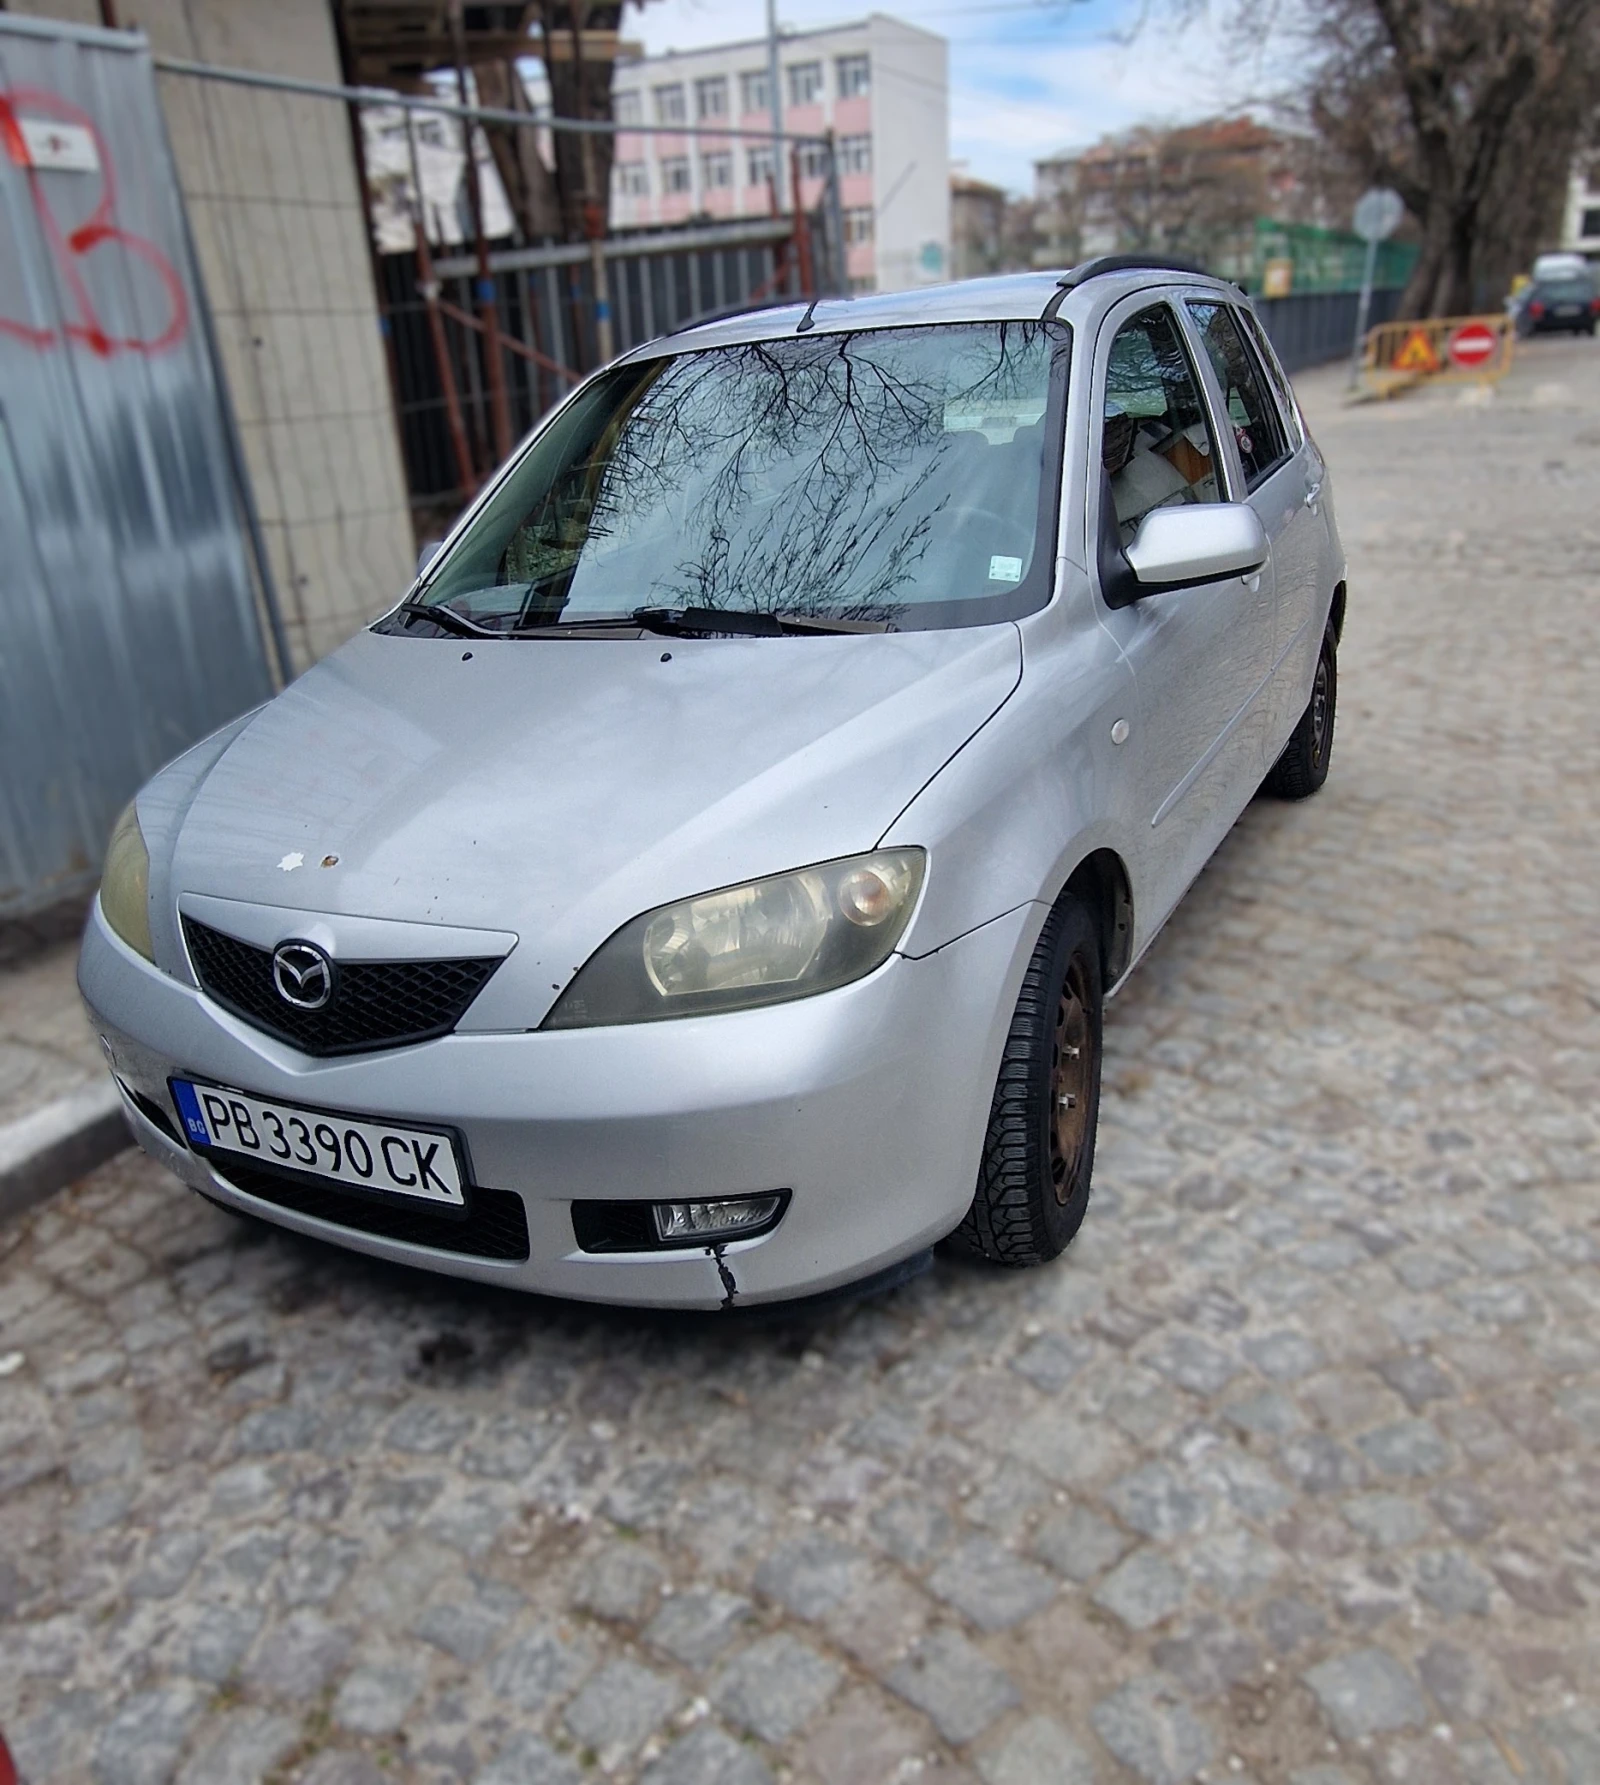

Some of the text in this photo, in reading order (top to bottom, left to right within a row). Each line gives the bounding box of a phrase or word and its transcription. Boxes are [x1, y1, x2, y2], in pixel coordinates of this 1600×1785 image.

[187, 1117, 206, 1135] BG
[202, 1093, 452, 1194] PB 3390 CK
